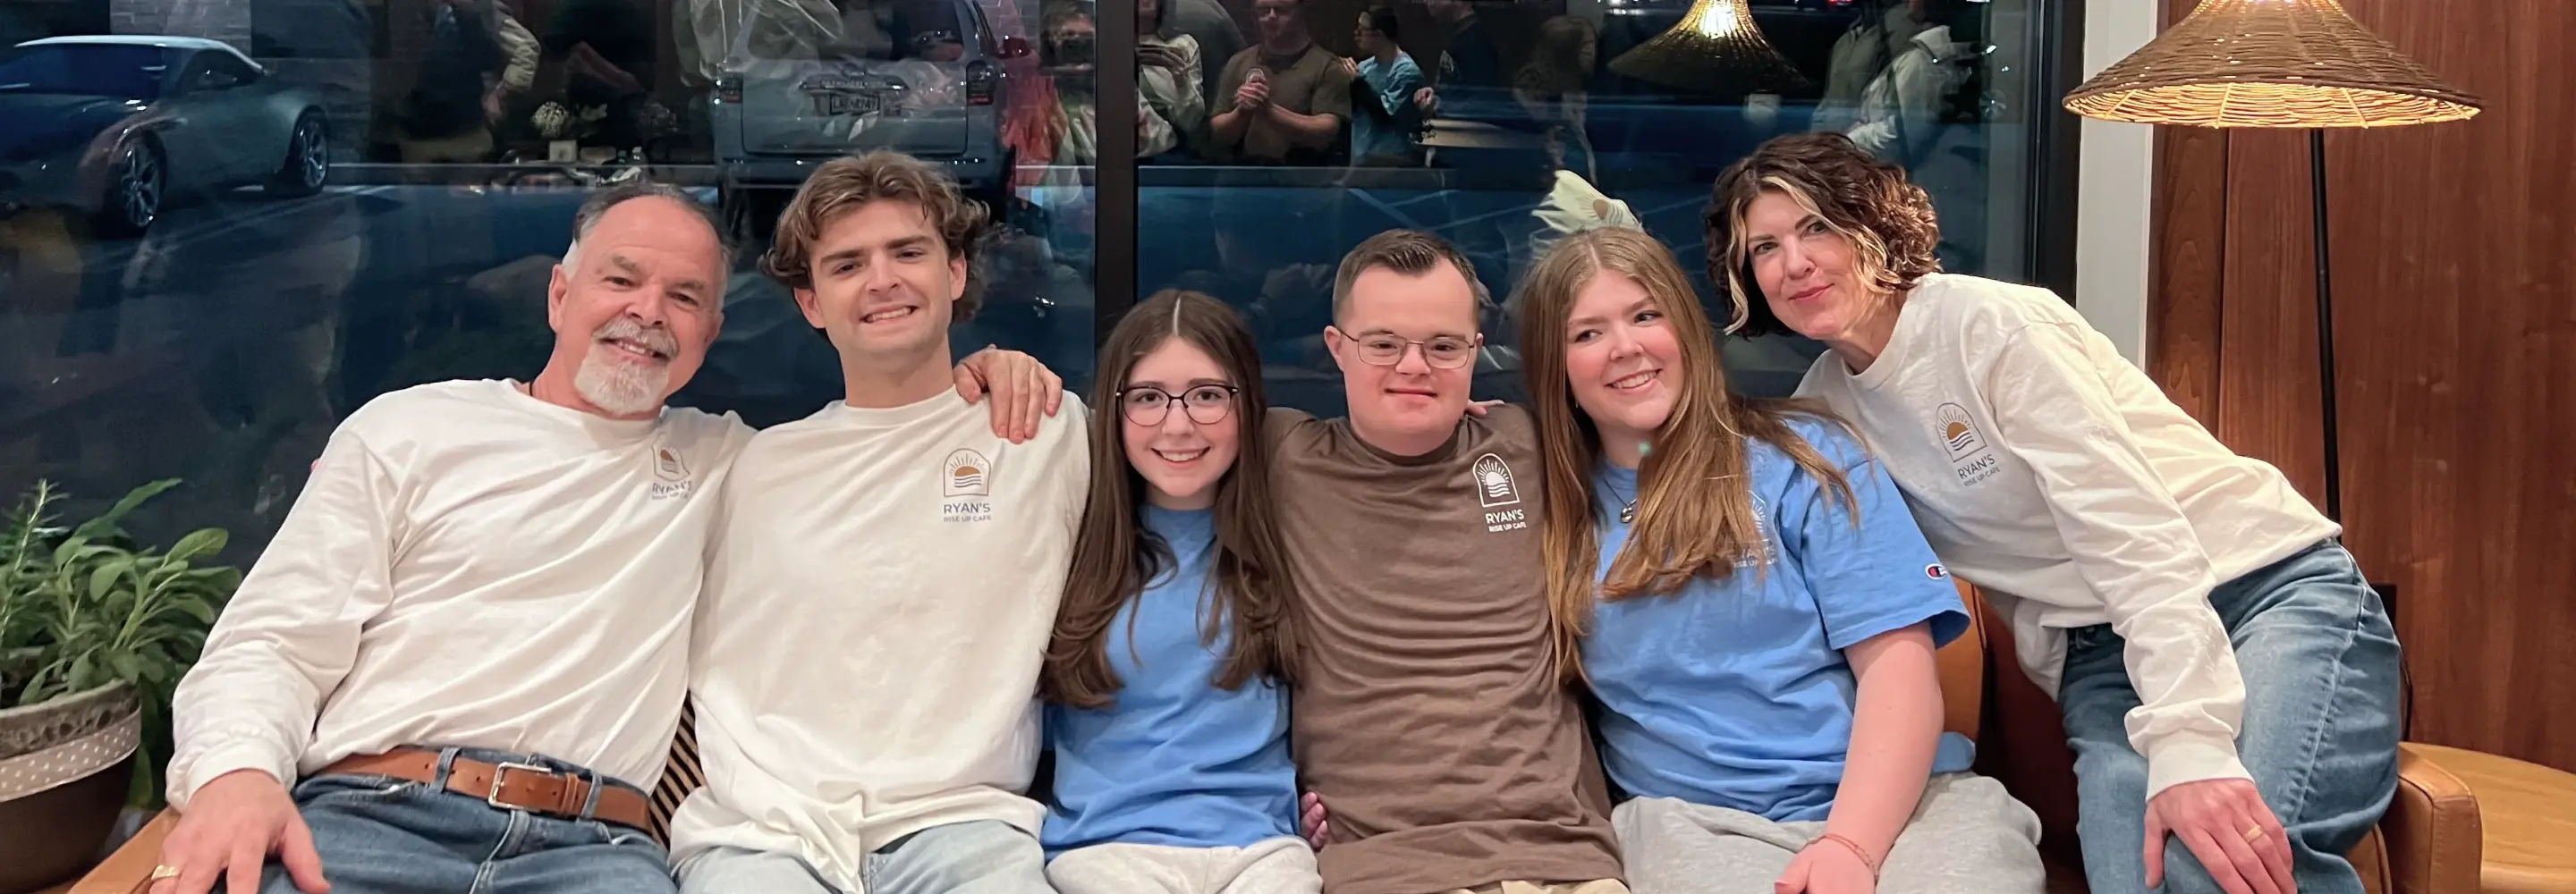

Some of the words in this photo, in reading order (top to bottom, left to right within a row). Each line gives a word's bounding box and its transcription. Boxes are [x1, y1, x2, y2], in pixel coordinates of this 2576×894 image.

[1957, 454, 1996, 479] RYAN'S
[1977, 472, 1985, 481] UP
[944, 502, 991, 514] RYAN'S
[1485, 509, 1524, 524] RYAN'S
[1488, 525, 1504, 533] RISE
[1504, 523, 1513, 531] UP
